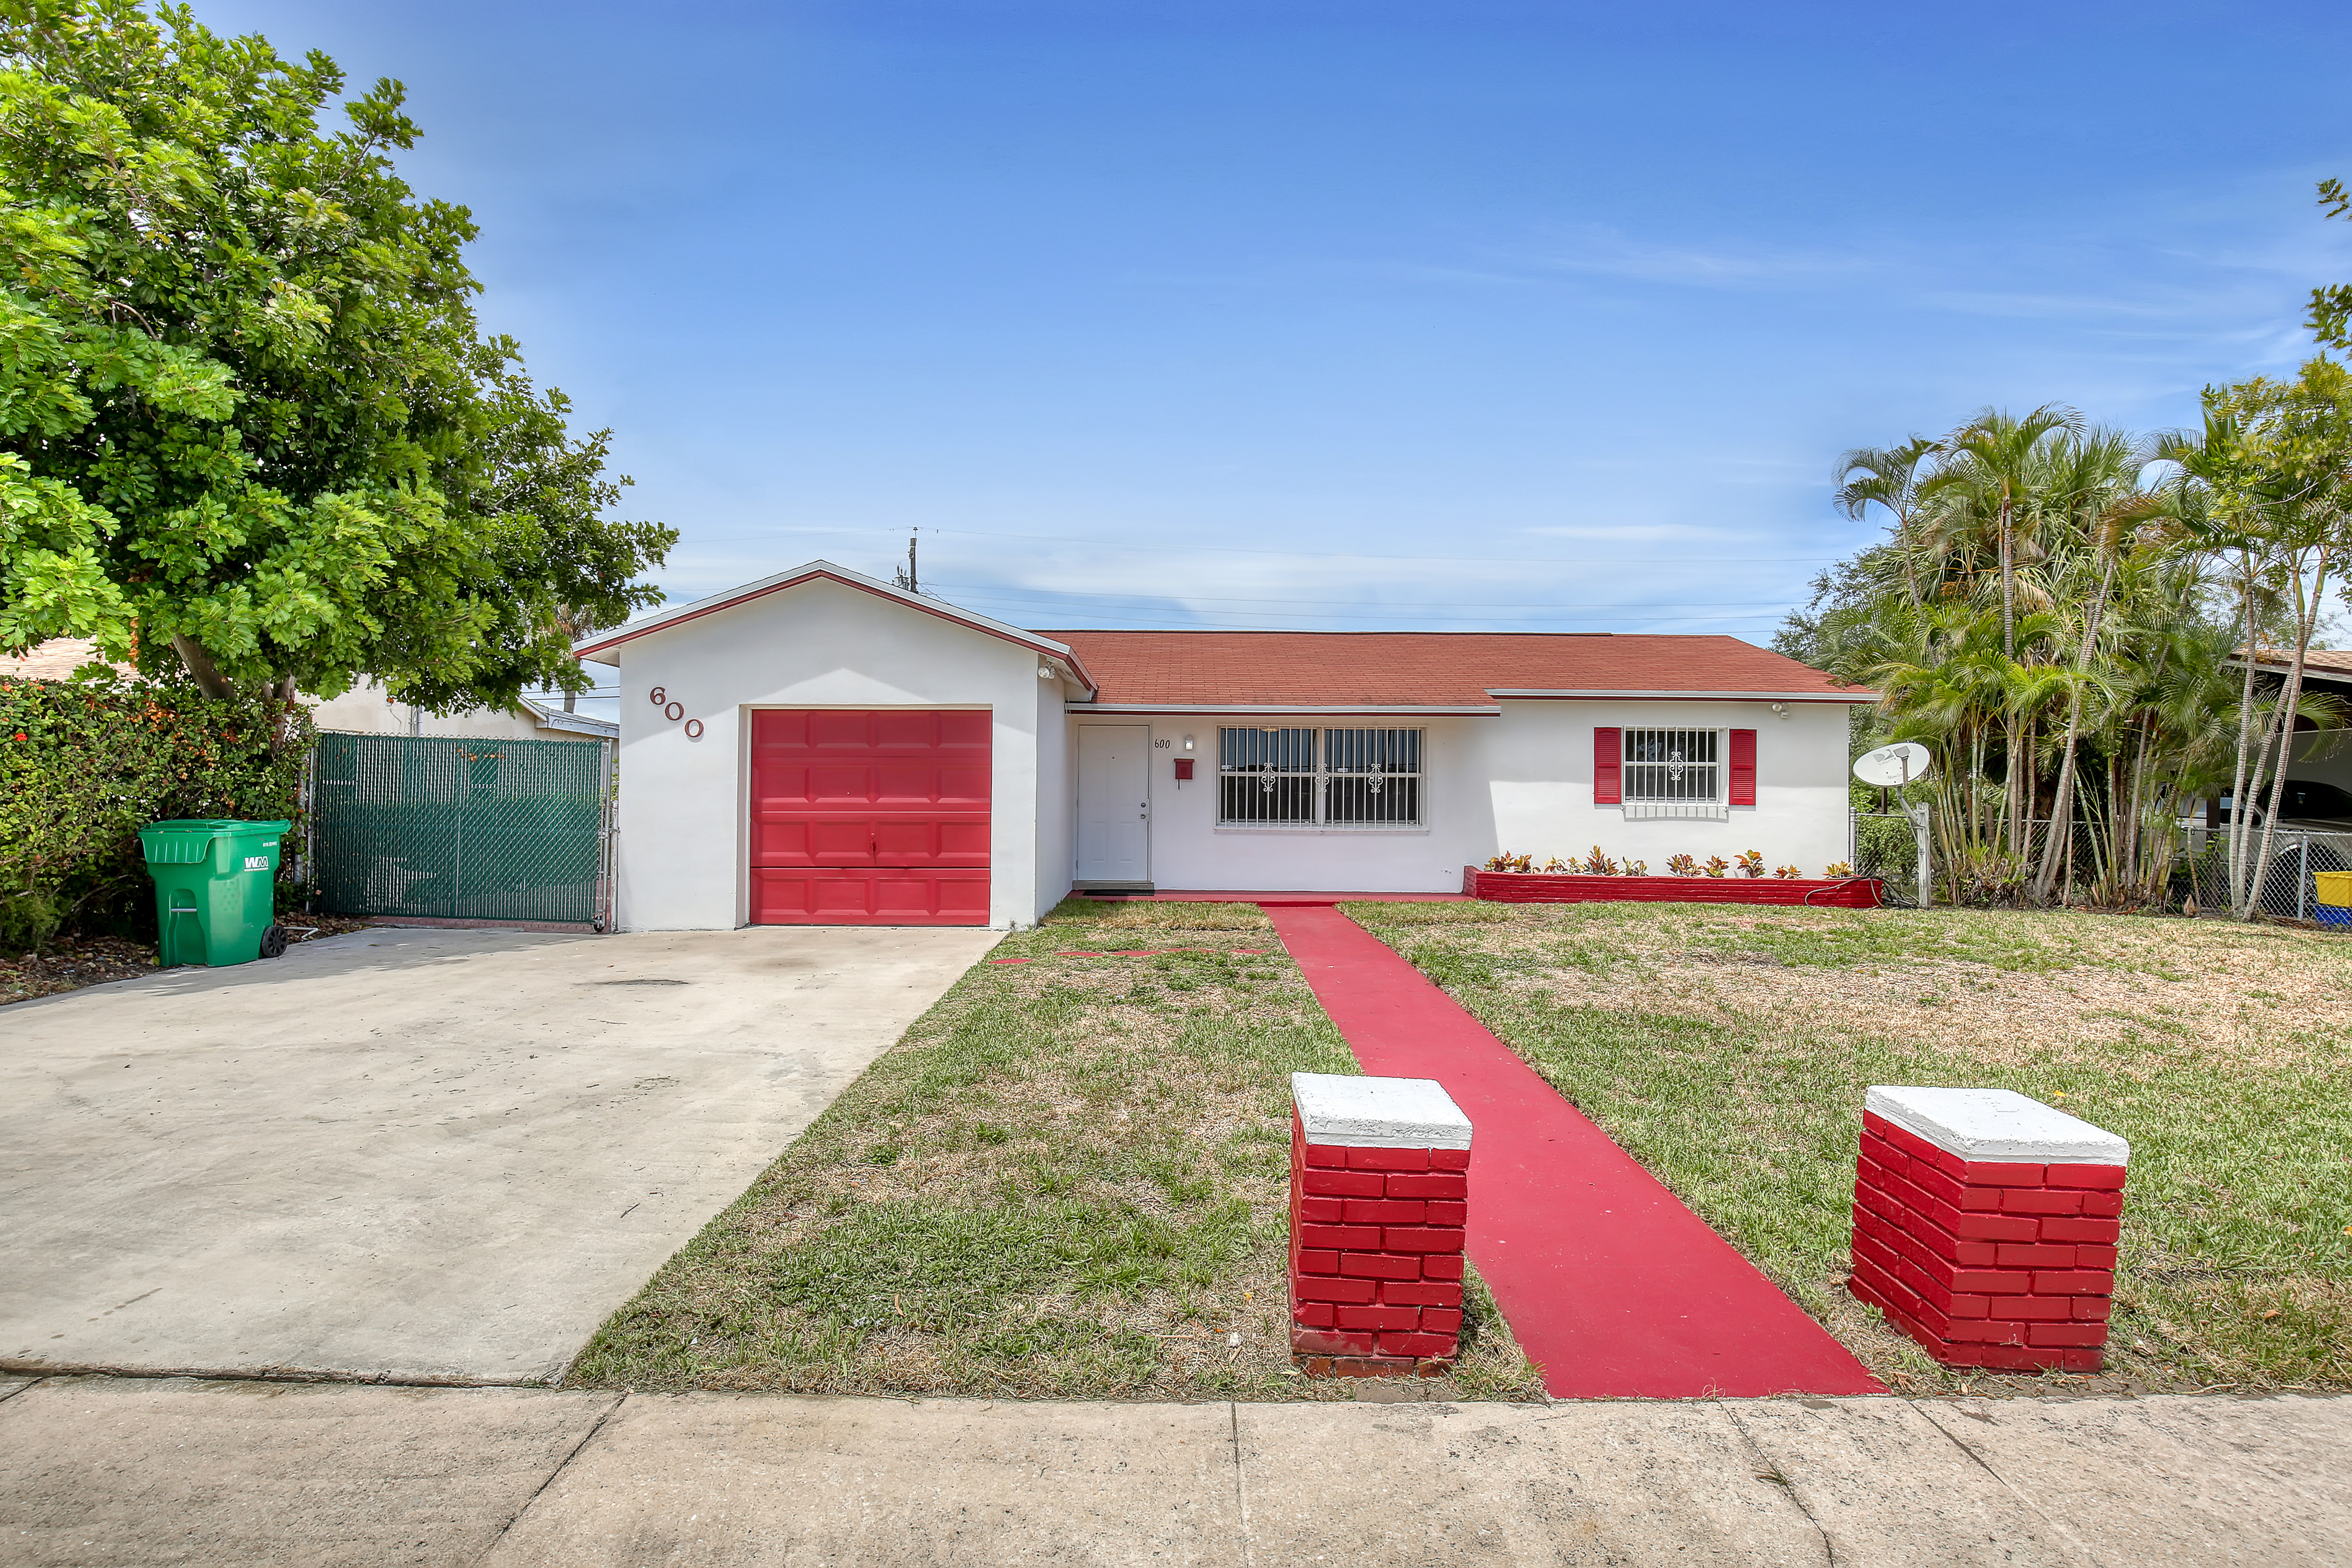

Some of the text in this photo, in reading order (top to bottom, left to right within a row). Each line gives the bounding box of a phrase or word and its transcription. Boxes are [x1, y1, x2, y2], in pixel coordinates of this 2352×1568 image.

[650, 687, 704, 737] 600
[1155, 739, 1170, 748] 600
[245, 856, 269, 868] WM
